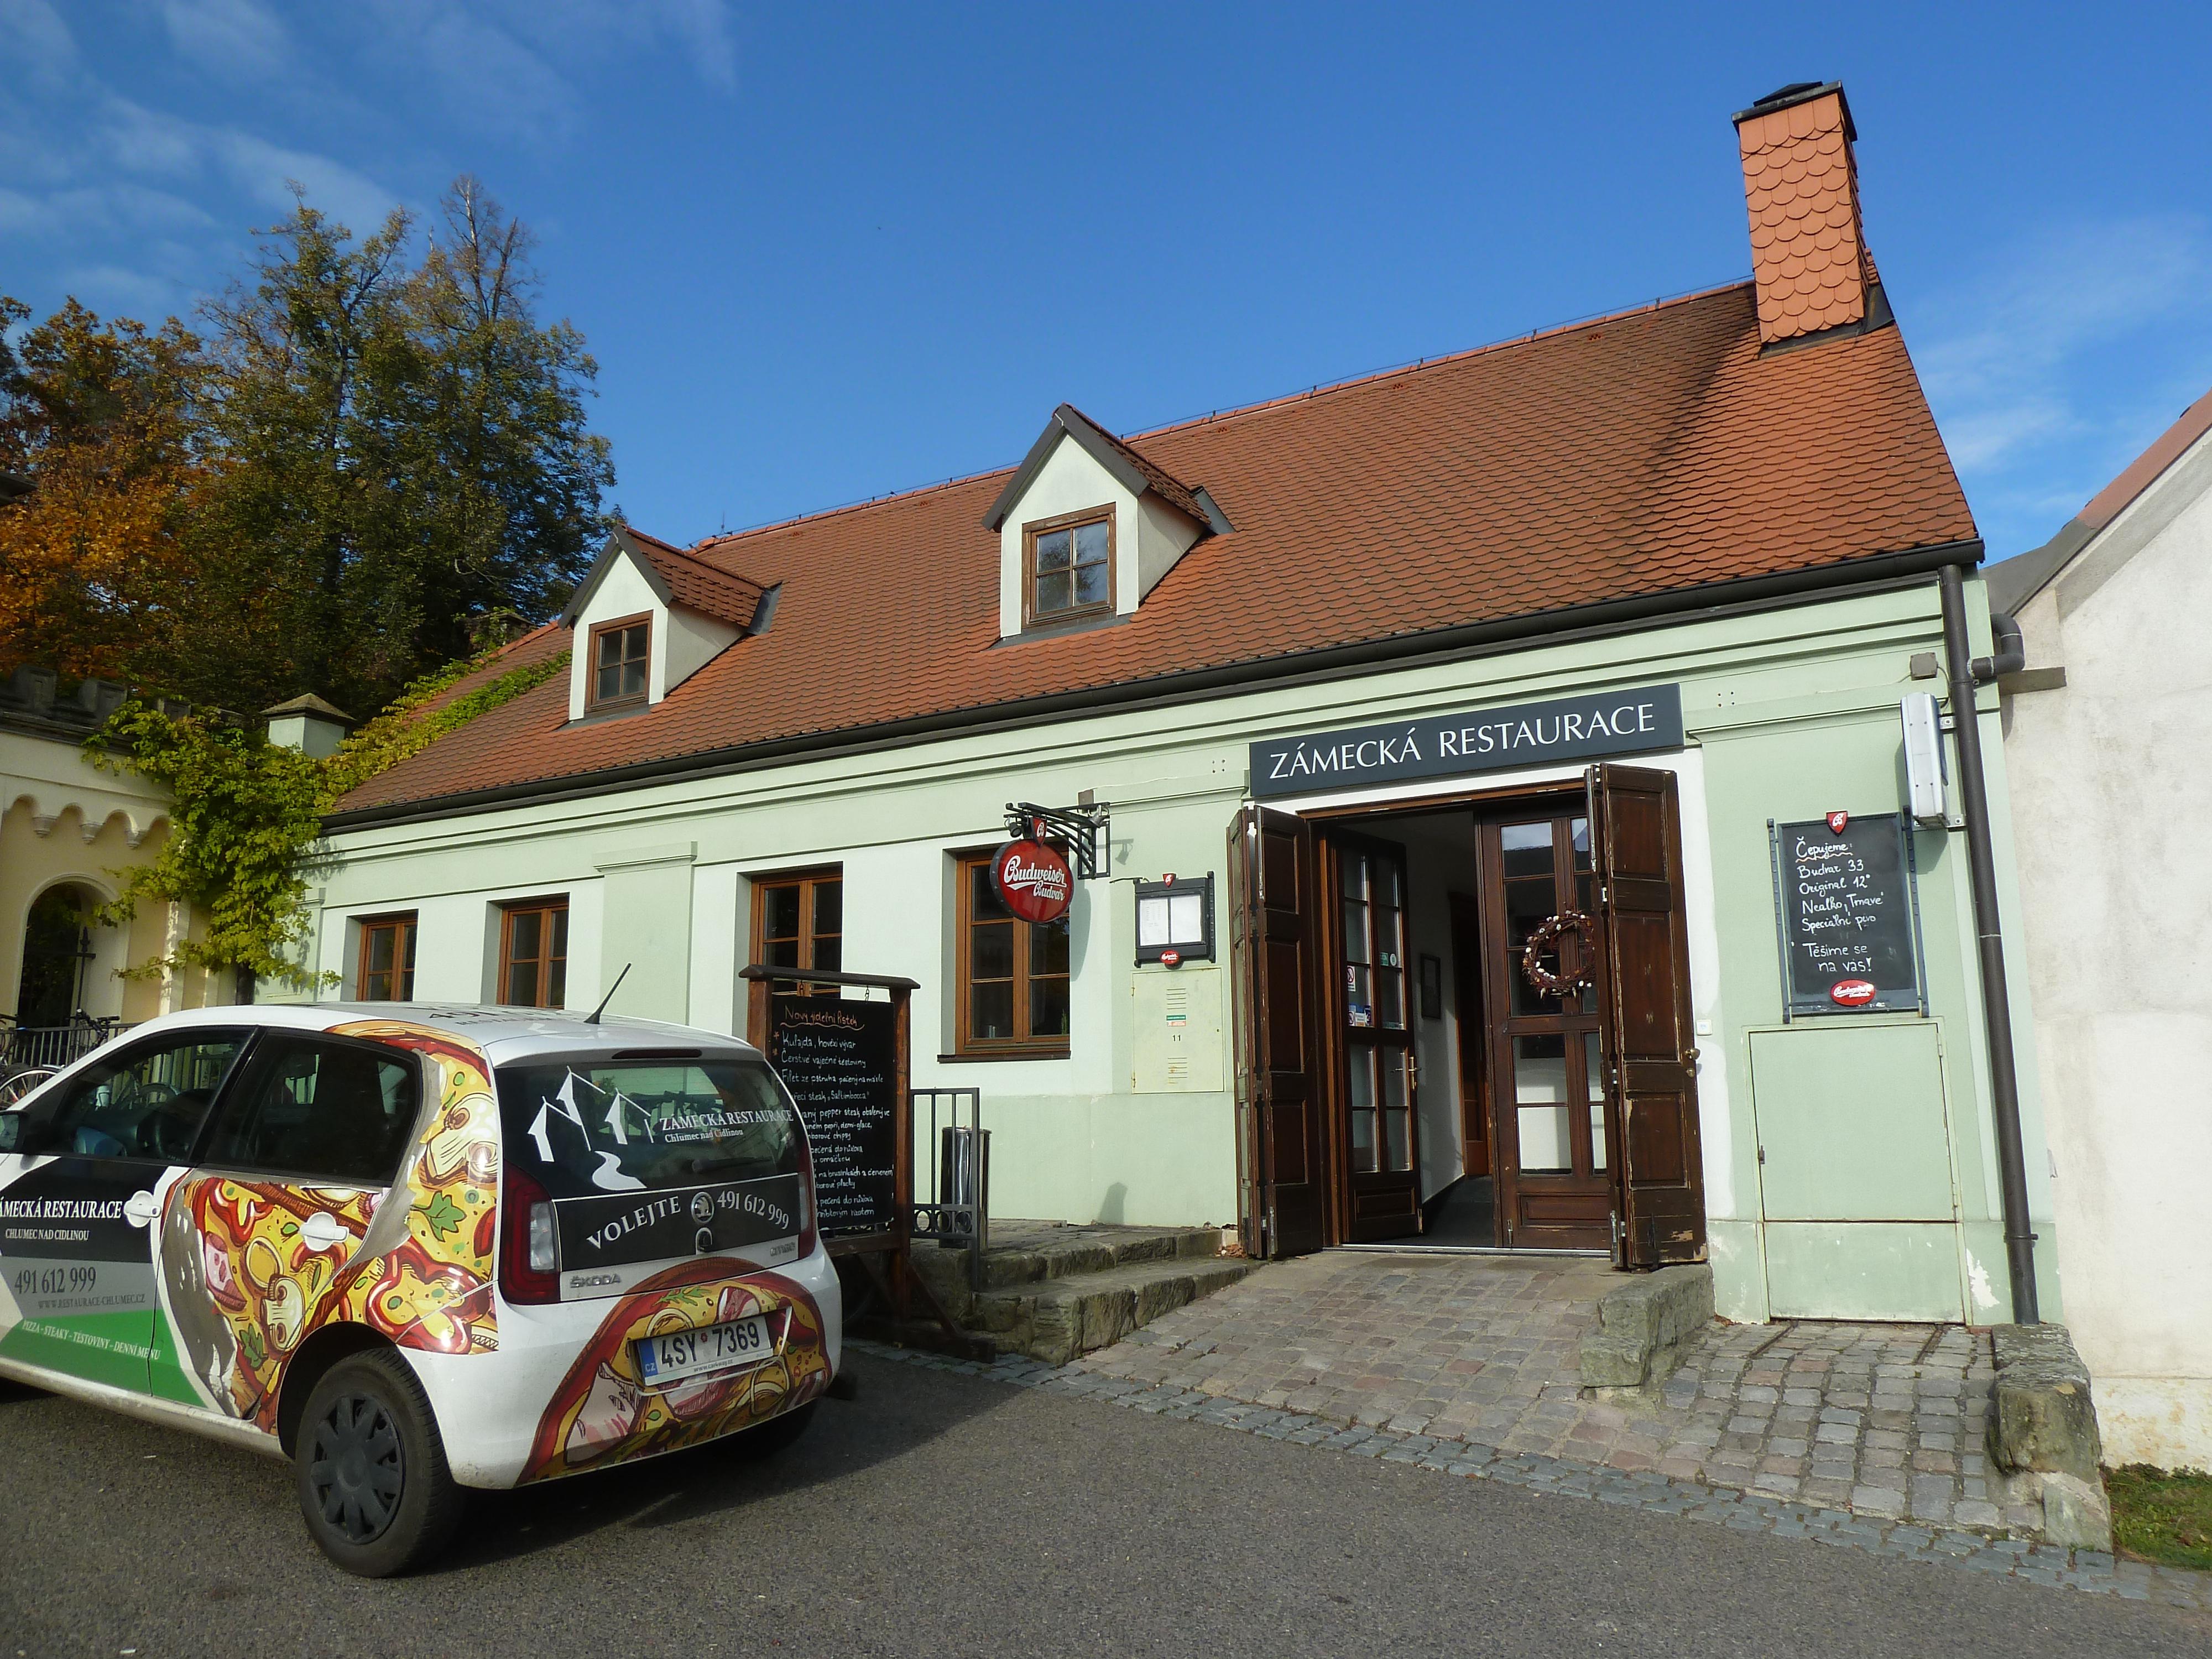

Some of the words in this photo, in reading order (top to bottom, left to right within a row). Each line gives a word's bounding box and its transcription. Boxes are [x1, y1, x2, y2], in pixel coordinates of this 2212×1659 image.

[1269, 727, 1422, 779] ZÁMECKÁ
[1439, 703, 1656, 758] RESTAURACE
[1796, 836, 1853, 859] Čepujeme:
[1003, 855, 1066, 885] Budweiser
[1797, 863, 1841, 879] Budvar
[1848, 859, 1864, 872] 33
[1033, 880, 1066, 901] Budvar
[1799, 877, 1847, 897] Original
[1846, 891, 1884, 908] Tmavé
[1855, 915, 1876, 931] pivo
[1854, 945, 1868, 954] se
[1818, 961, 1838, 972] na
[781, 1068, 800, 1083] Filet
[660, 1110, 728, 1131] ZÁMECKÁ
[726, 1109, 794, 1125] RESTAURACE
[664, 1133, 700, 1144] Chlumec
[700, 1131, 714, 1140] nad
[714, 1128, 744, 1138] Cidlinou
[44, 1201, 123, 1219] RESTAURACE
[586, 1196, 682, 1250] VOLEJTE
[717, 1190, 740, 1210] 491
[744, 1194, 765, 1217] 612
[768, 1203, 790, 1230] 999
[5, 1228, 38, 1239] CHLUMEC
[38, 1229, 54, 1240] NAD
[54, 1229, 90, 1241] CIDLINOU
[14, 1270, 37, 1295] 491
[41, 1268, 65, 1294] 612
[69, 1266, 97, 1292] 999
[570, 1274, 622, 1288] ŠKODA
[22, 1319, 40, 1332] PIZZA
[44, 1325, 70, 1340] STEAKY
[661, 1333, 697, 1368] 4SY
[712, 1322, 760, 1357] 7369
[645, 1362, 656, 1372] CZ
